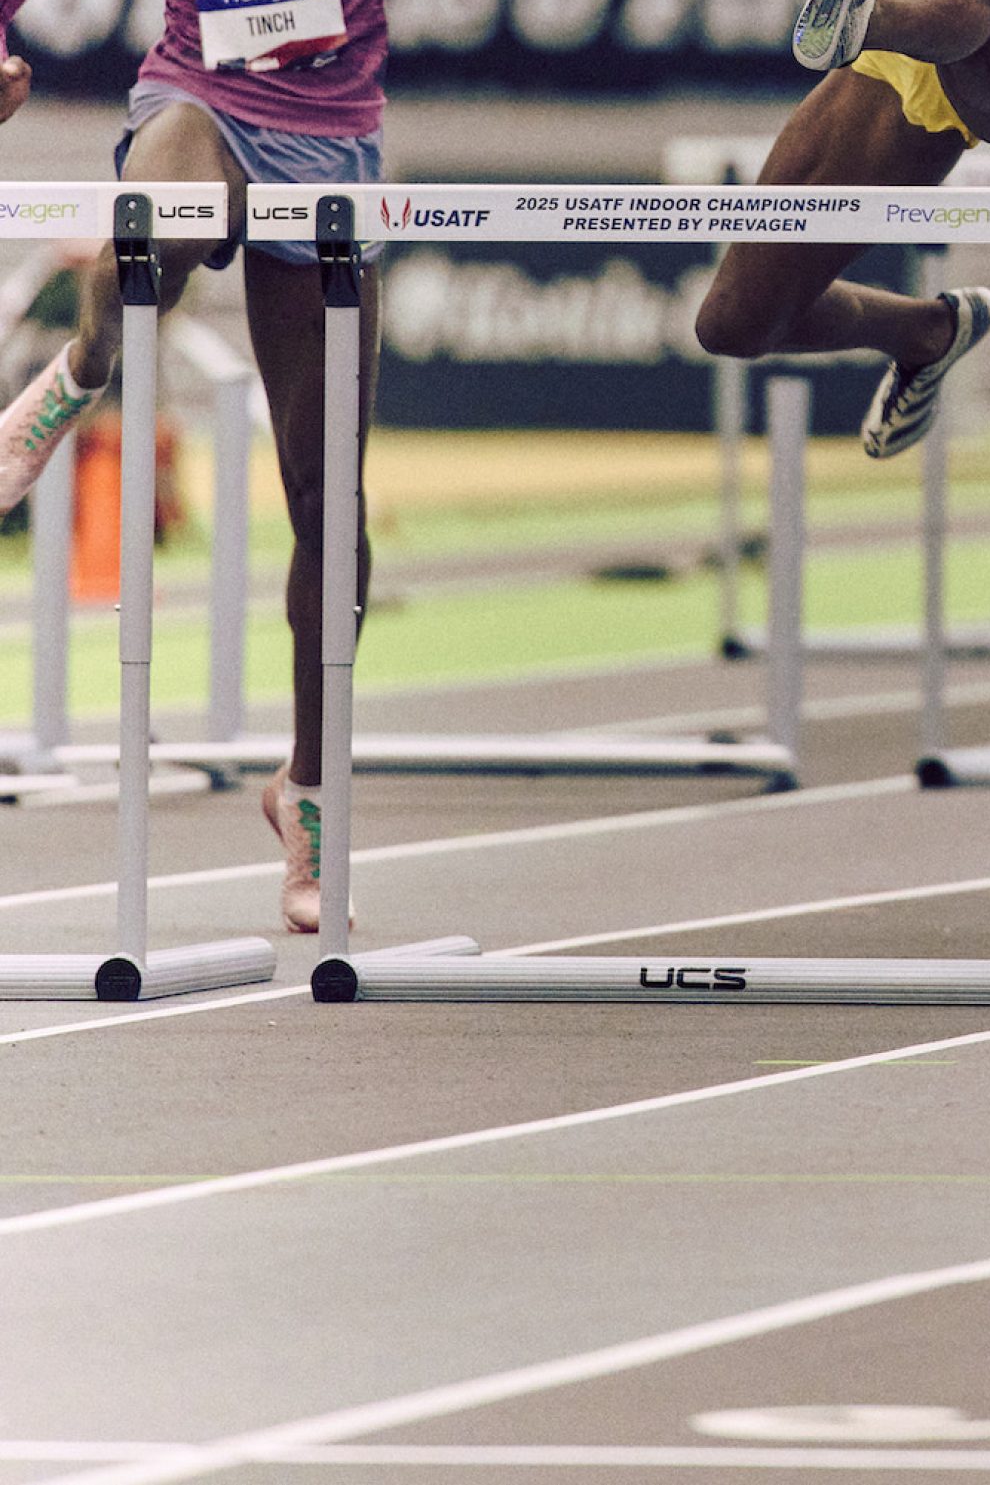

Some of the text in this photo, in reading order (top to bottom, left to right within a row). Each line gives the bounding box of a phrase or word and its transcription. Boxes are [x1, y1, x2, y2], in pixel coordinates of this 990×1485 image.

[247, 10, 296, 37] TINCH
[0, 203, 76, 224] evagen
[158, 205, 215, 219] UCS
[252, 206, 309, 220] UCS
[515, 197, 861, 212] 2025 USATF INDOOR CHAMPIONSHIPS
[414, 209, 491, 227] USATF
[563, 217, 807, 232] PRESENTED BY PREVAGEN
[886, 204, 990, 228] Prevagen
[640, 967, 746, 990] UCS
